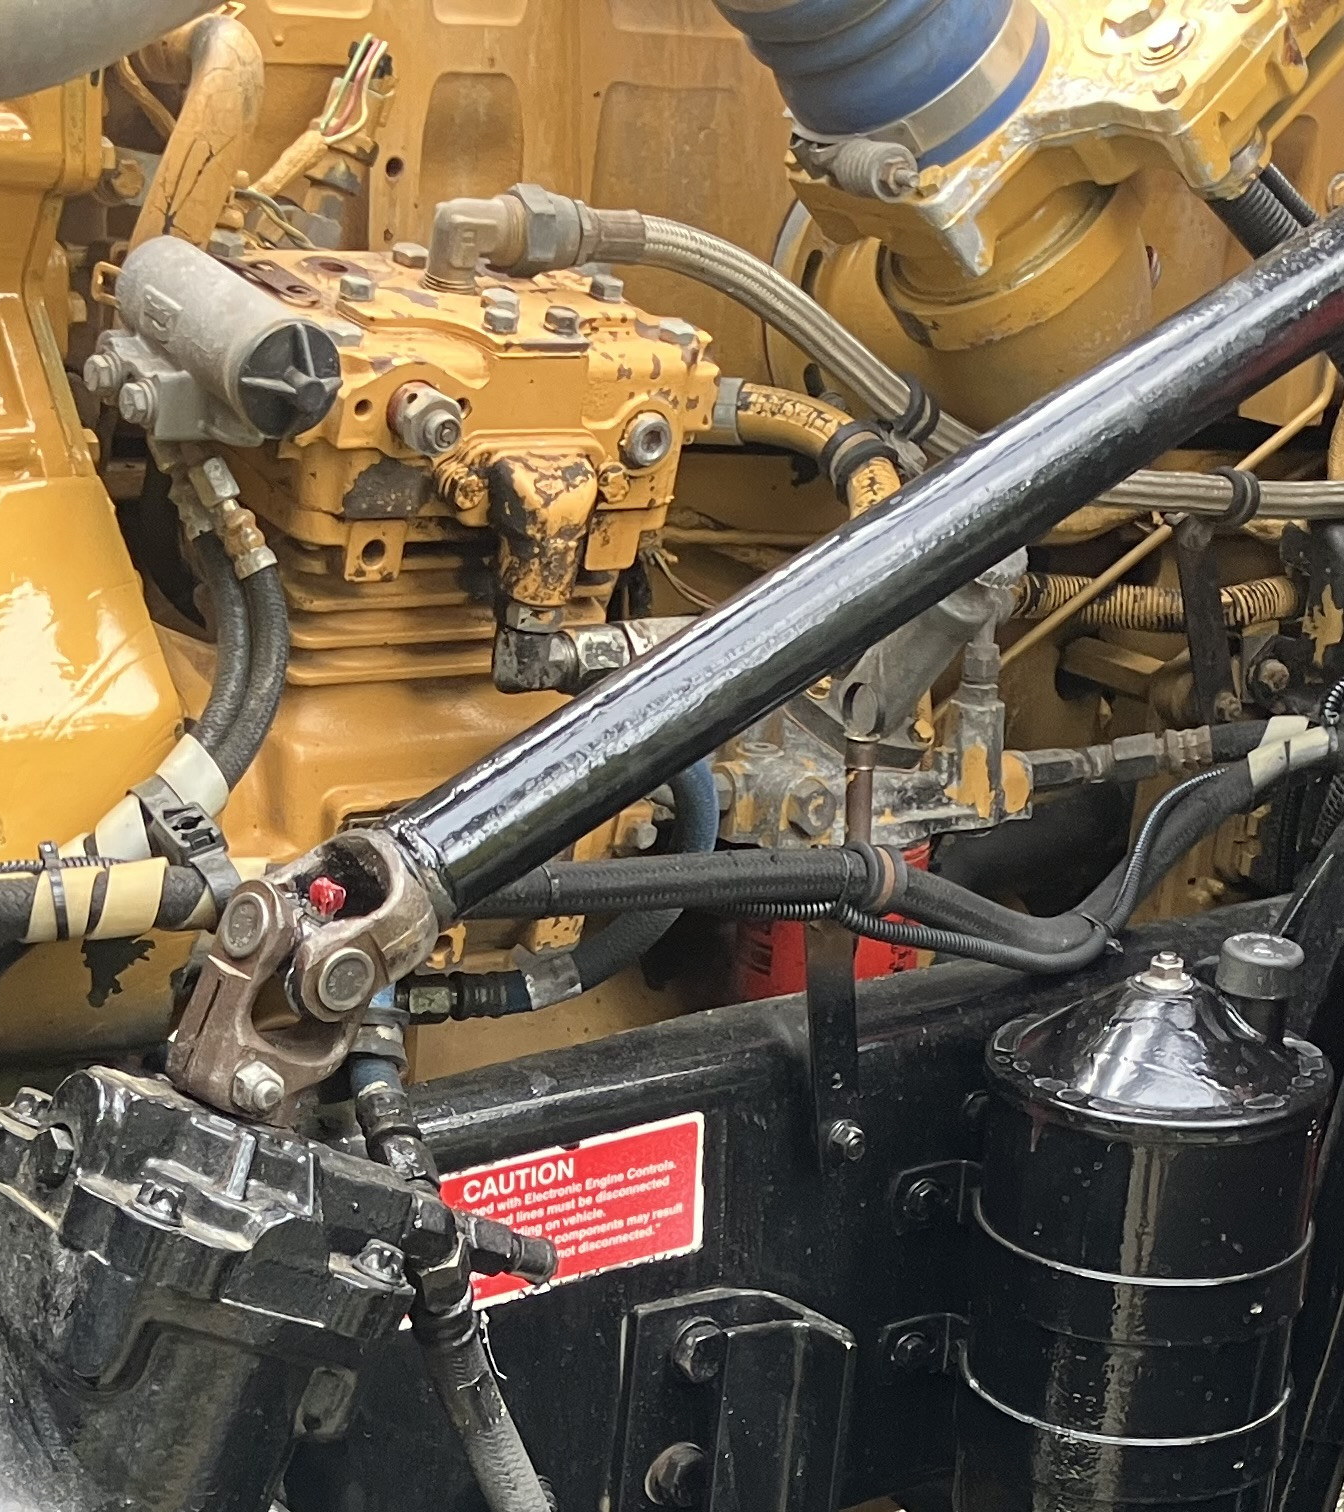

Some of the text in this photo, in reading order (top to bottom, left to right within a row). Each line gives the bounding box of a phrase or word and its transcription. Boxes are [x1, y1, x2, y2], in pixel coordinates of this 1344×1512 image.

[463, 1157, 574, 1203] CAUTION
[497, 1197, 522, 1211] with
[524, 1182, 583, 1205] Electronic
[585, 1172, 624, 1190] Engine
[627, 1160, 676, 1180] Controls.
[516, 1207, 544, 1223] lines
[547, 1198, 575, 1215] must
[578, 1196, 593, 1208] be
[595, 1175, 670, 1203] disconnected
[545, 1219, 560, 1231] on
[562, 1208, 606, 1226] vehicle.
[554, 1202, 683, 1244] components may result
